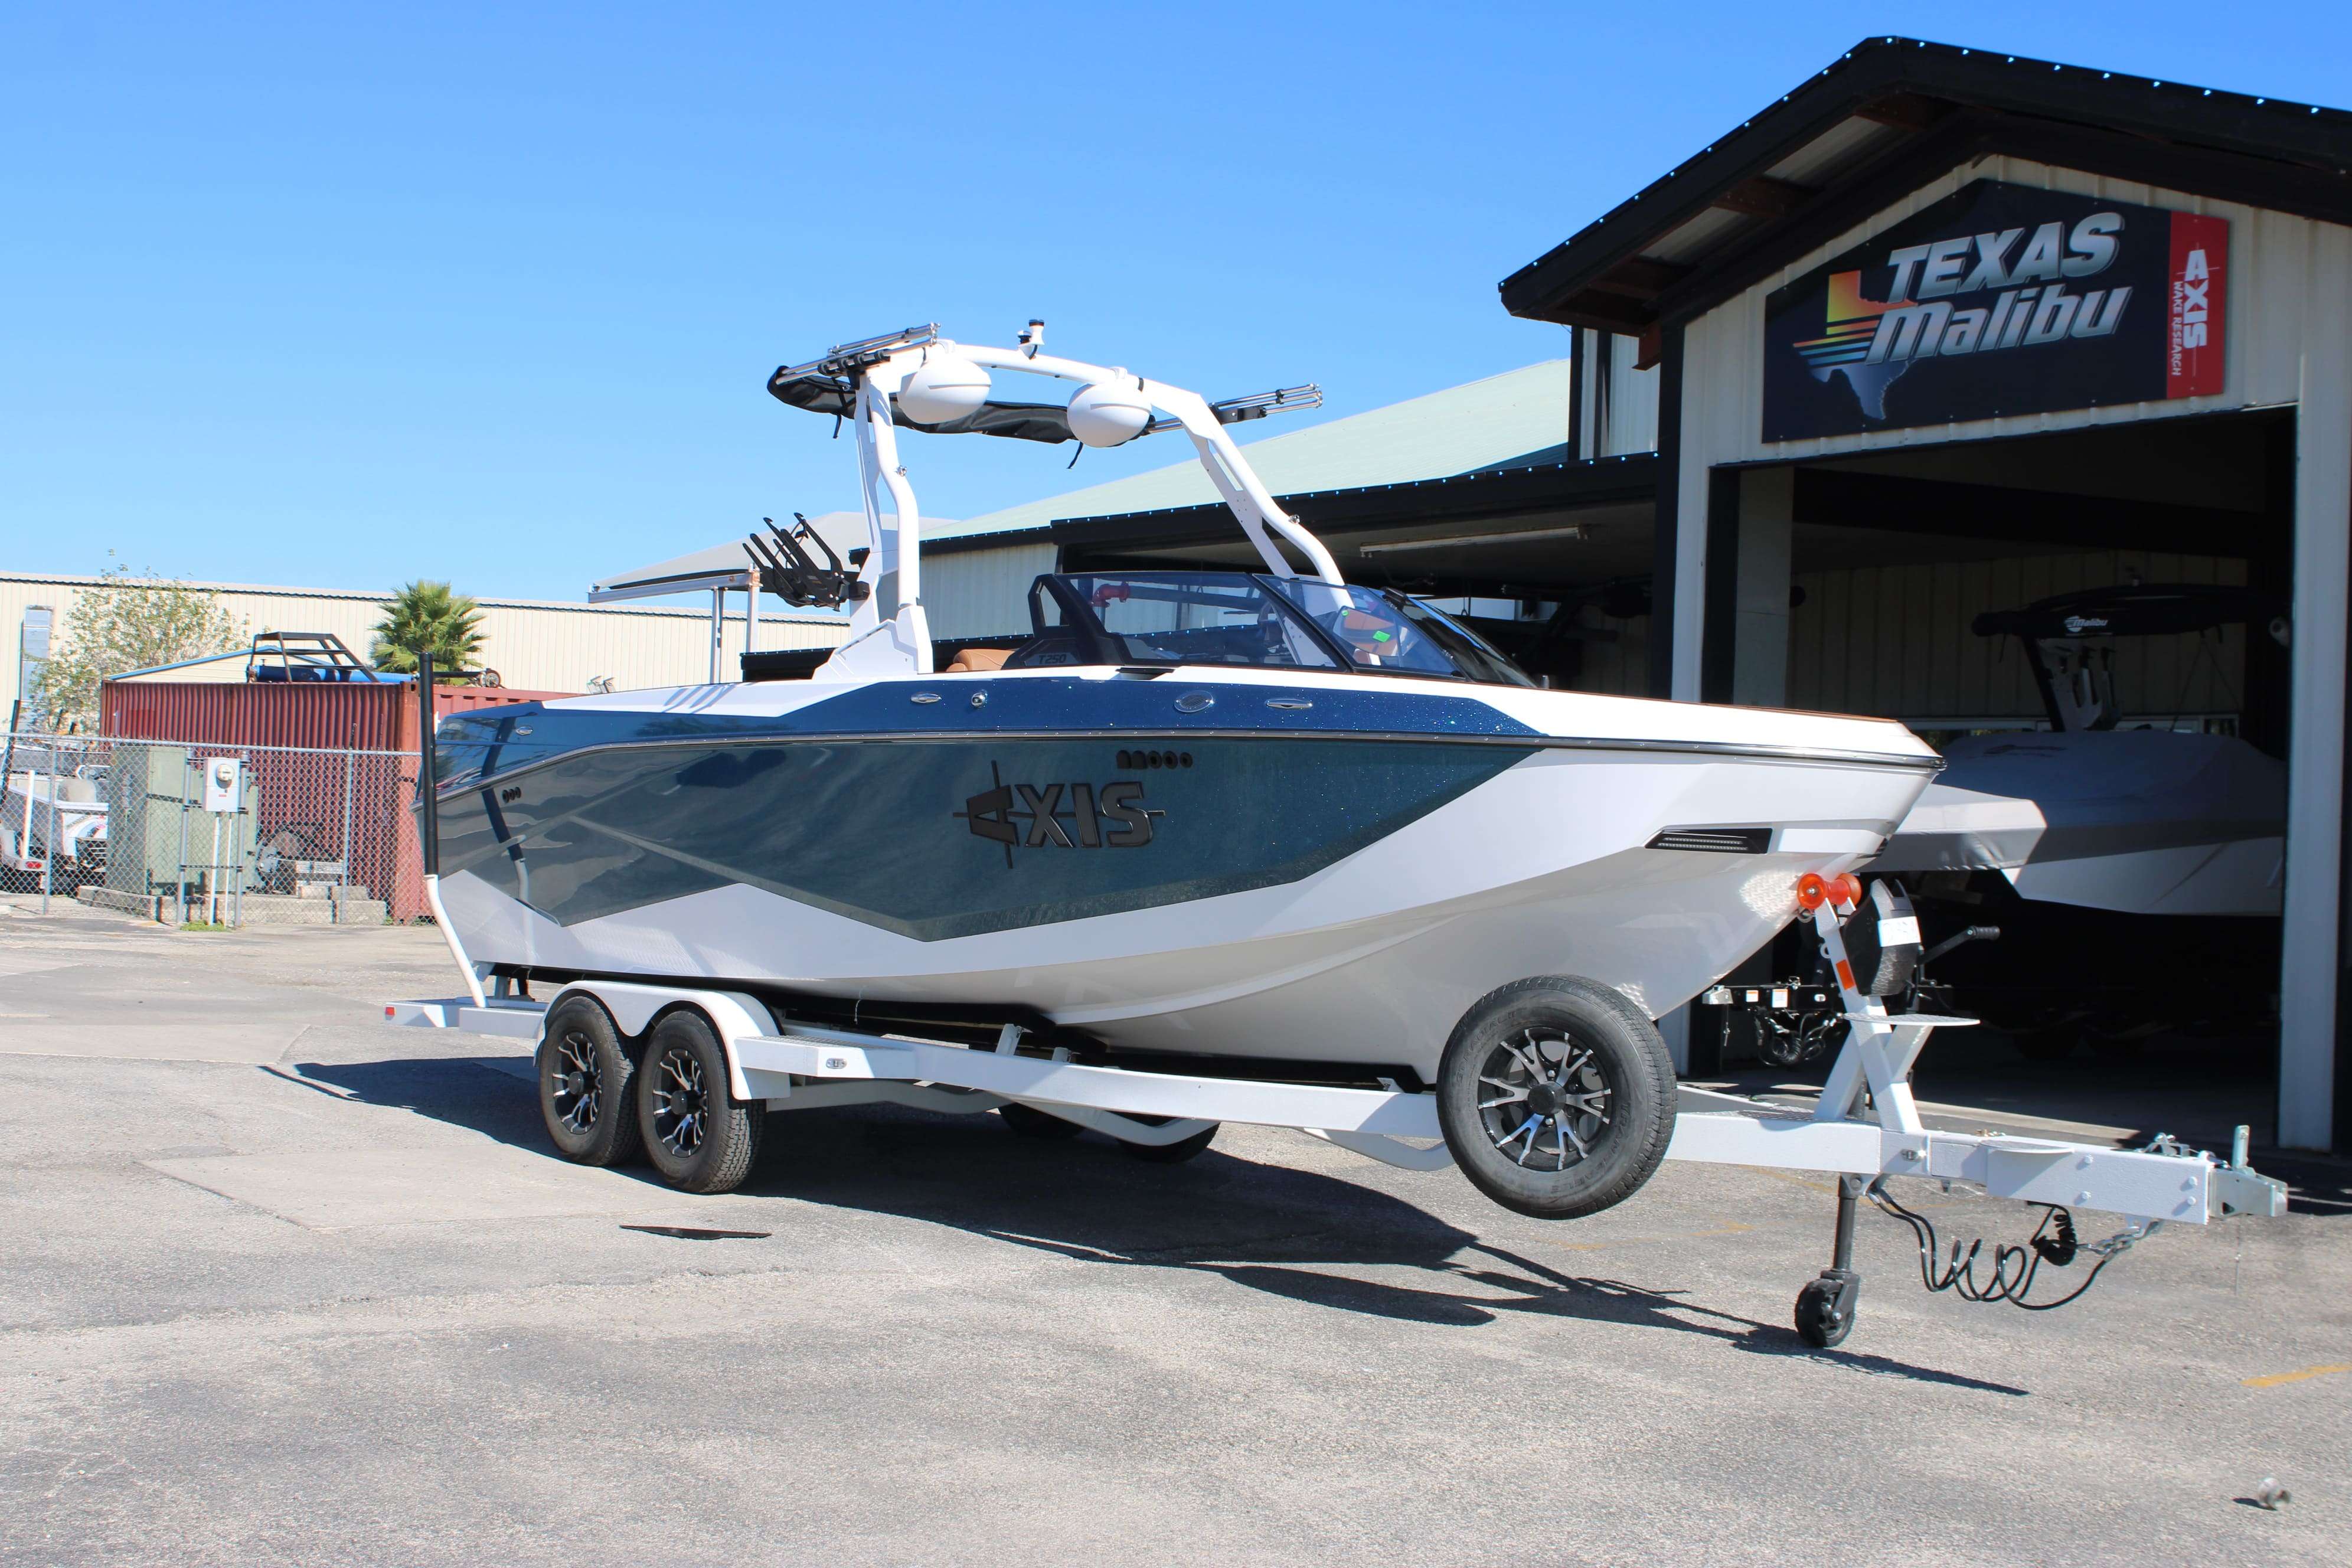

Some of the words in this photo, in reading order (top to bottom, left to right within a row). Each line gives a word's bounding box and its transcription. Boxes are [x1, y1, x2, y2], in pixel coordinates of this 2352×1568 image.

[1887, 212, 2125, 303] TEXAS
[1864, 283, 2134, 365] Malibu
[2173, 280, 2184, 314] WAKE
[2183, 249, 2209, 349] AXIS
[2171, 316, 2183, 376] RESEARCH
[1039, 654, 1067, 664] T250
[966, 781, 1154, 848] AXIS
